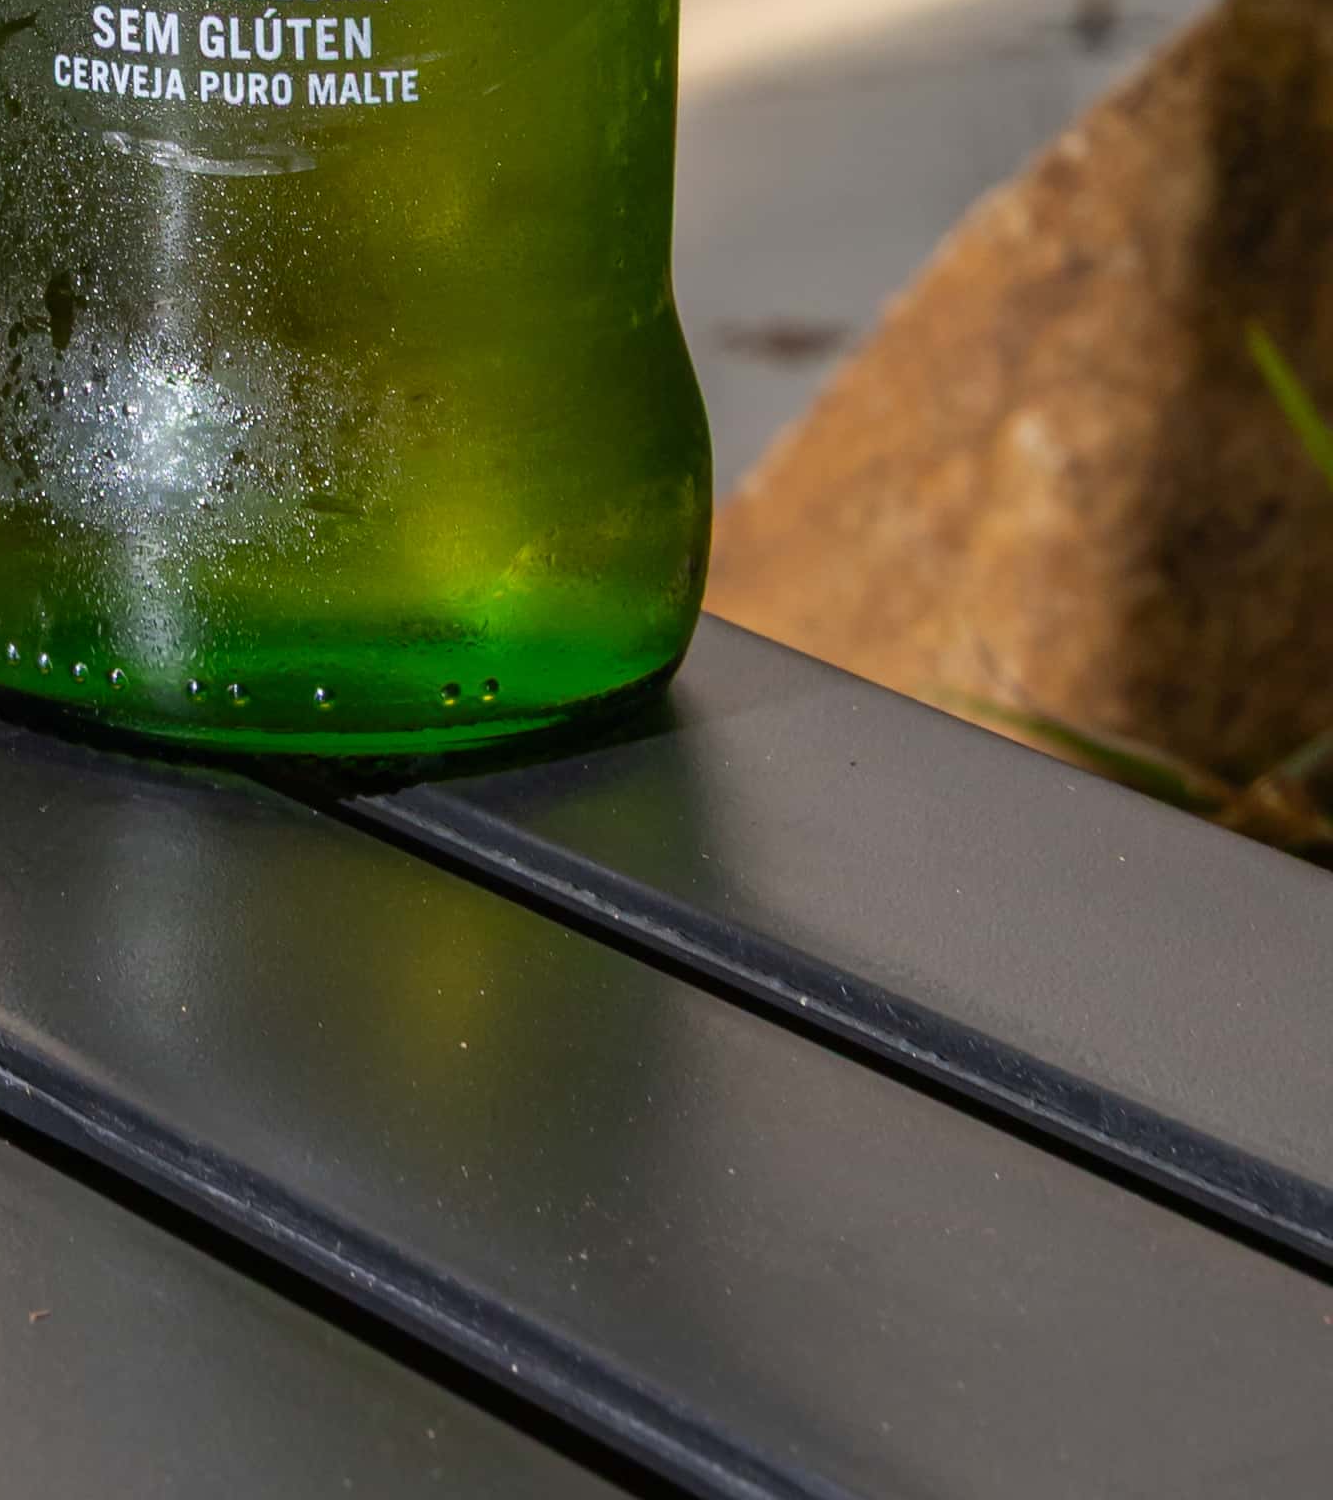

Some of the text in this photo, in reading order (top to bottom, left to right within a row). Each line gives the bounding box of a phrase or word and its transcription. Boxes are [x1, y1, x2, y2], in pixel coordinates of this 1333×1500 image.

[91, 4, 373, 62] SEM GLÚTEN
[52, 53, 420, 107] CERVEJA PURO MALTE
